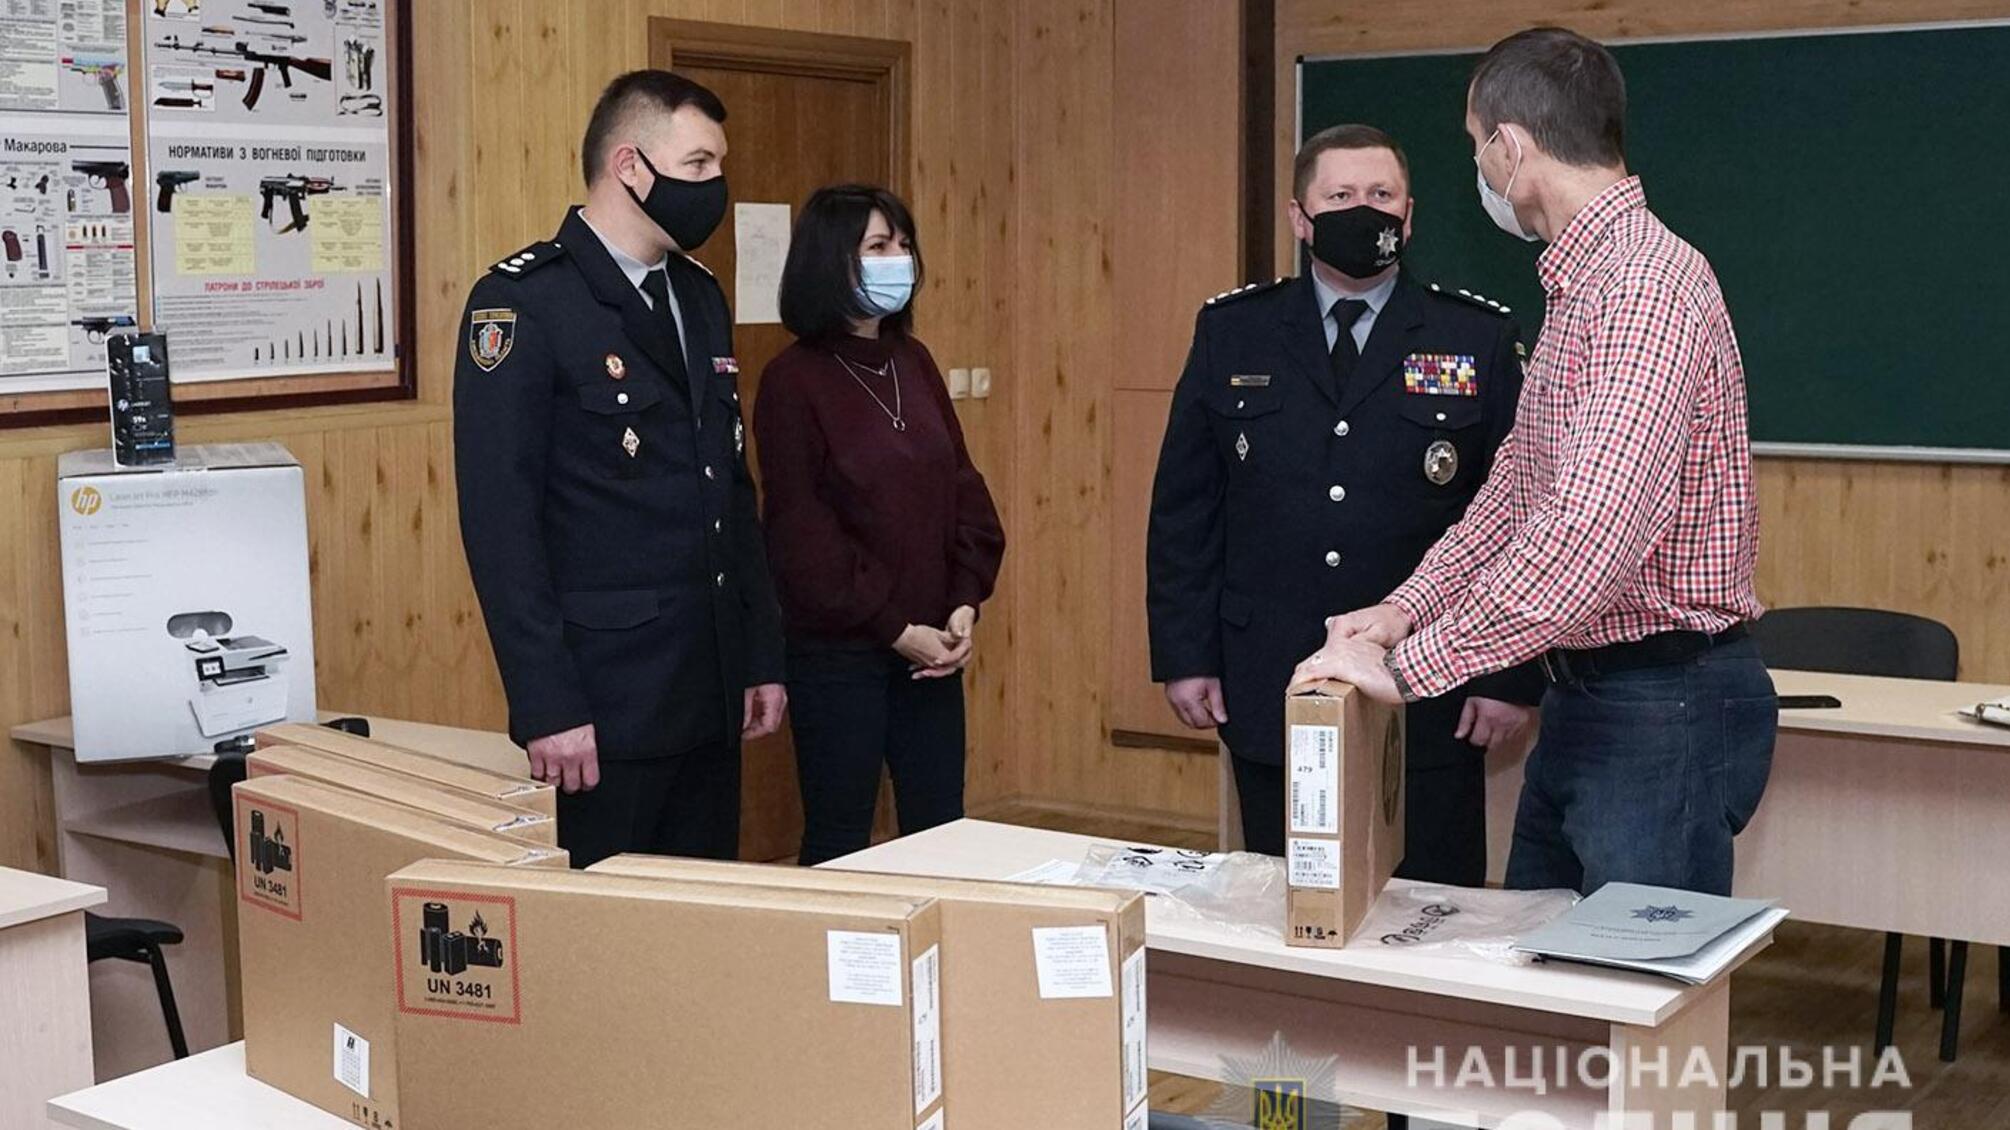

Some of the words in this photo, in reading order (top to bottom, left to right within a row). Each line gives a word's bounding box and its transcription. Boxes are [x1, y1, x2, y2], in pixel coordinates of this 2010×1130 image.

[4, 138, 67, 154] Макарова
[169, 145, 234, 160] НОРМАТИВИ
[239, 147, 247, 160] З
[252, 146, 301, 161] ВОГНЕВОЇ
[306, 149, 367, 162] ПІДГОТОВКИ
[73, 486, 100, 515] hp
[254, 874, 266, 890] UN
[268, 879, 287, 898] 3481
[427, 978, 450, 994] UN
[456, 981, 491, 999] 3481
